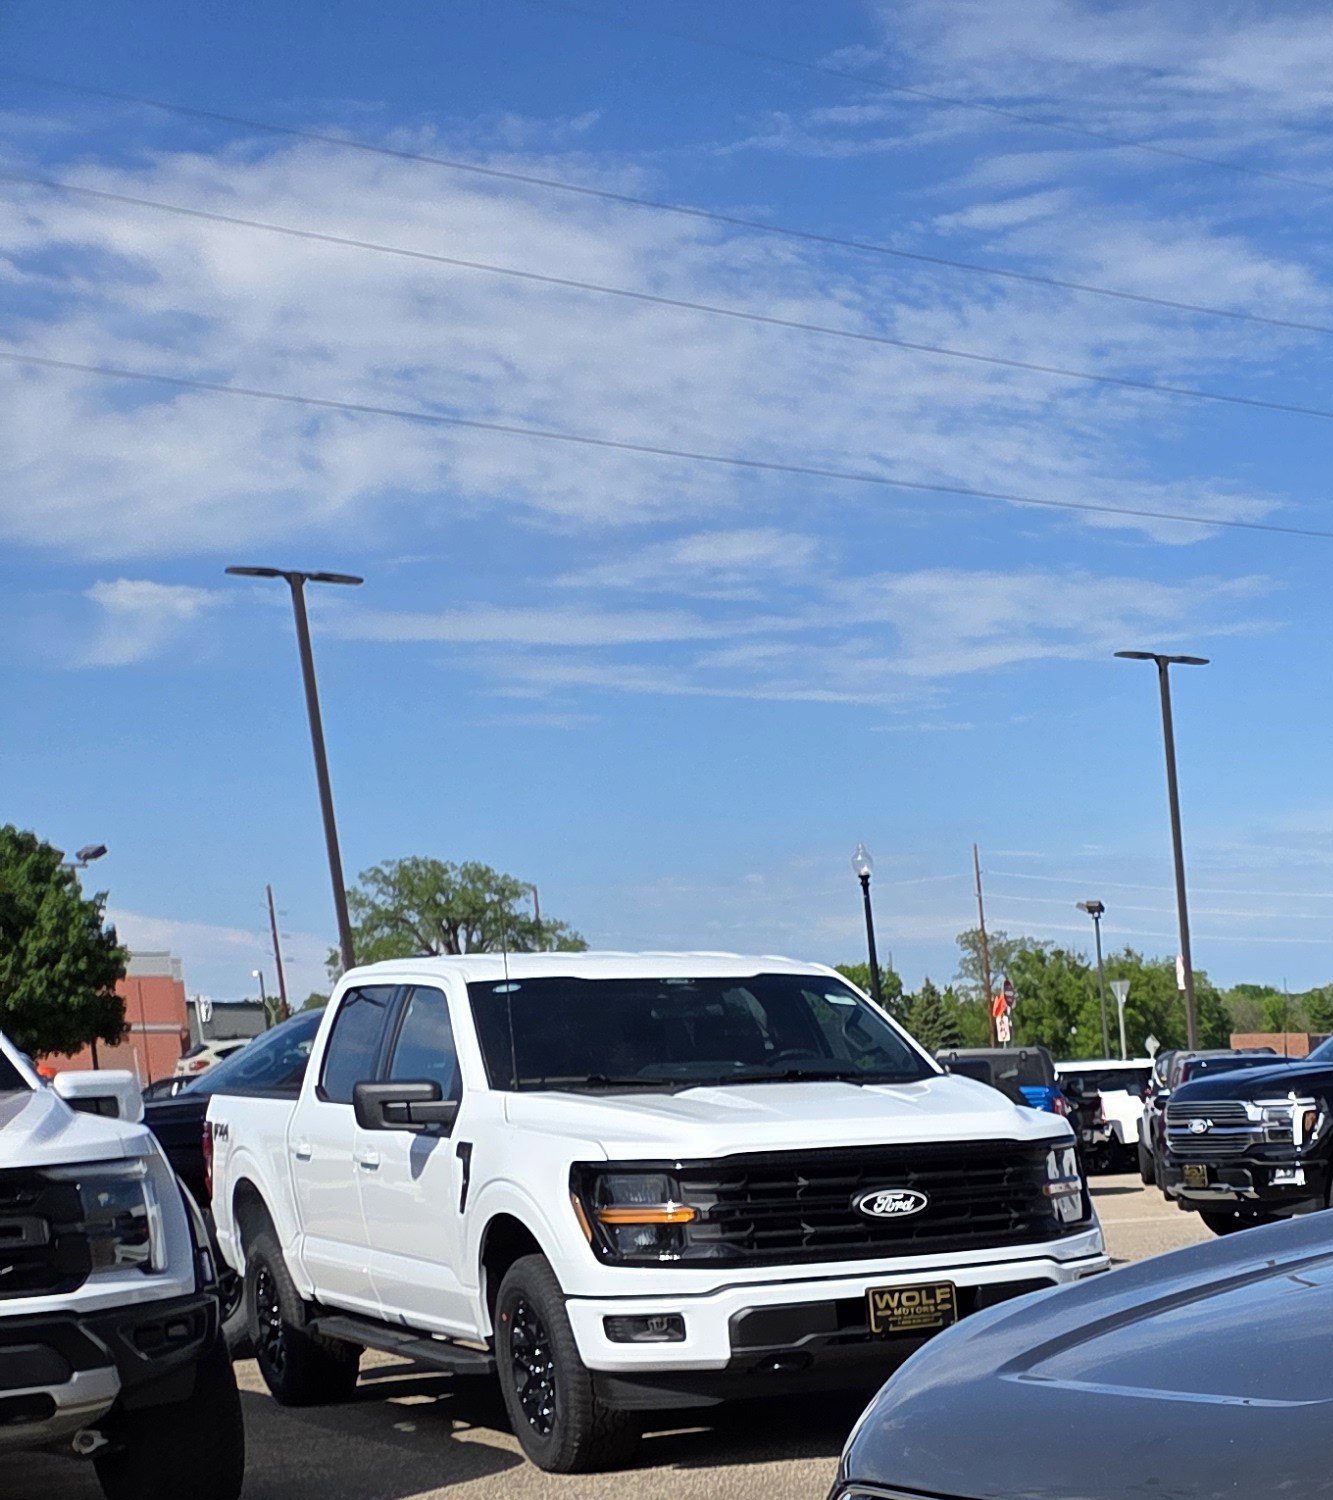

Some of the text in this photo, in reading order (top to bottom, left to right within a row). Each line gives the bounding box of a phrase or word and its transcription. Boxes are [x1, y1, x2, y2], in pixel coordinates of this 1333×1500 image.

[873, 1193, 915, 1214] Ford
[875, 1287, 951, 1309] WOLF
[893, 1305, 936, 1316] MOTORS
